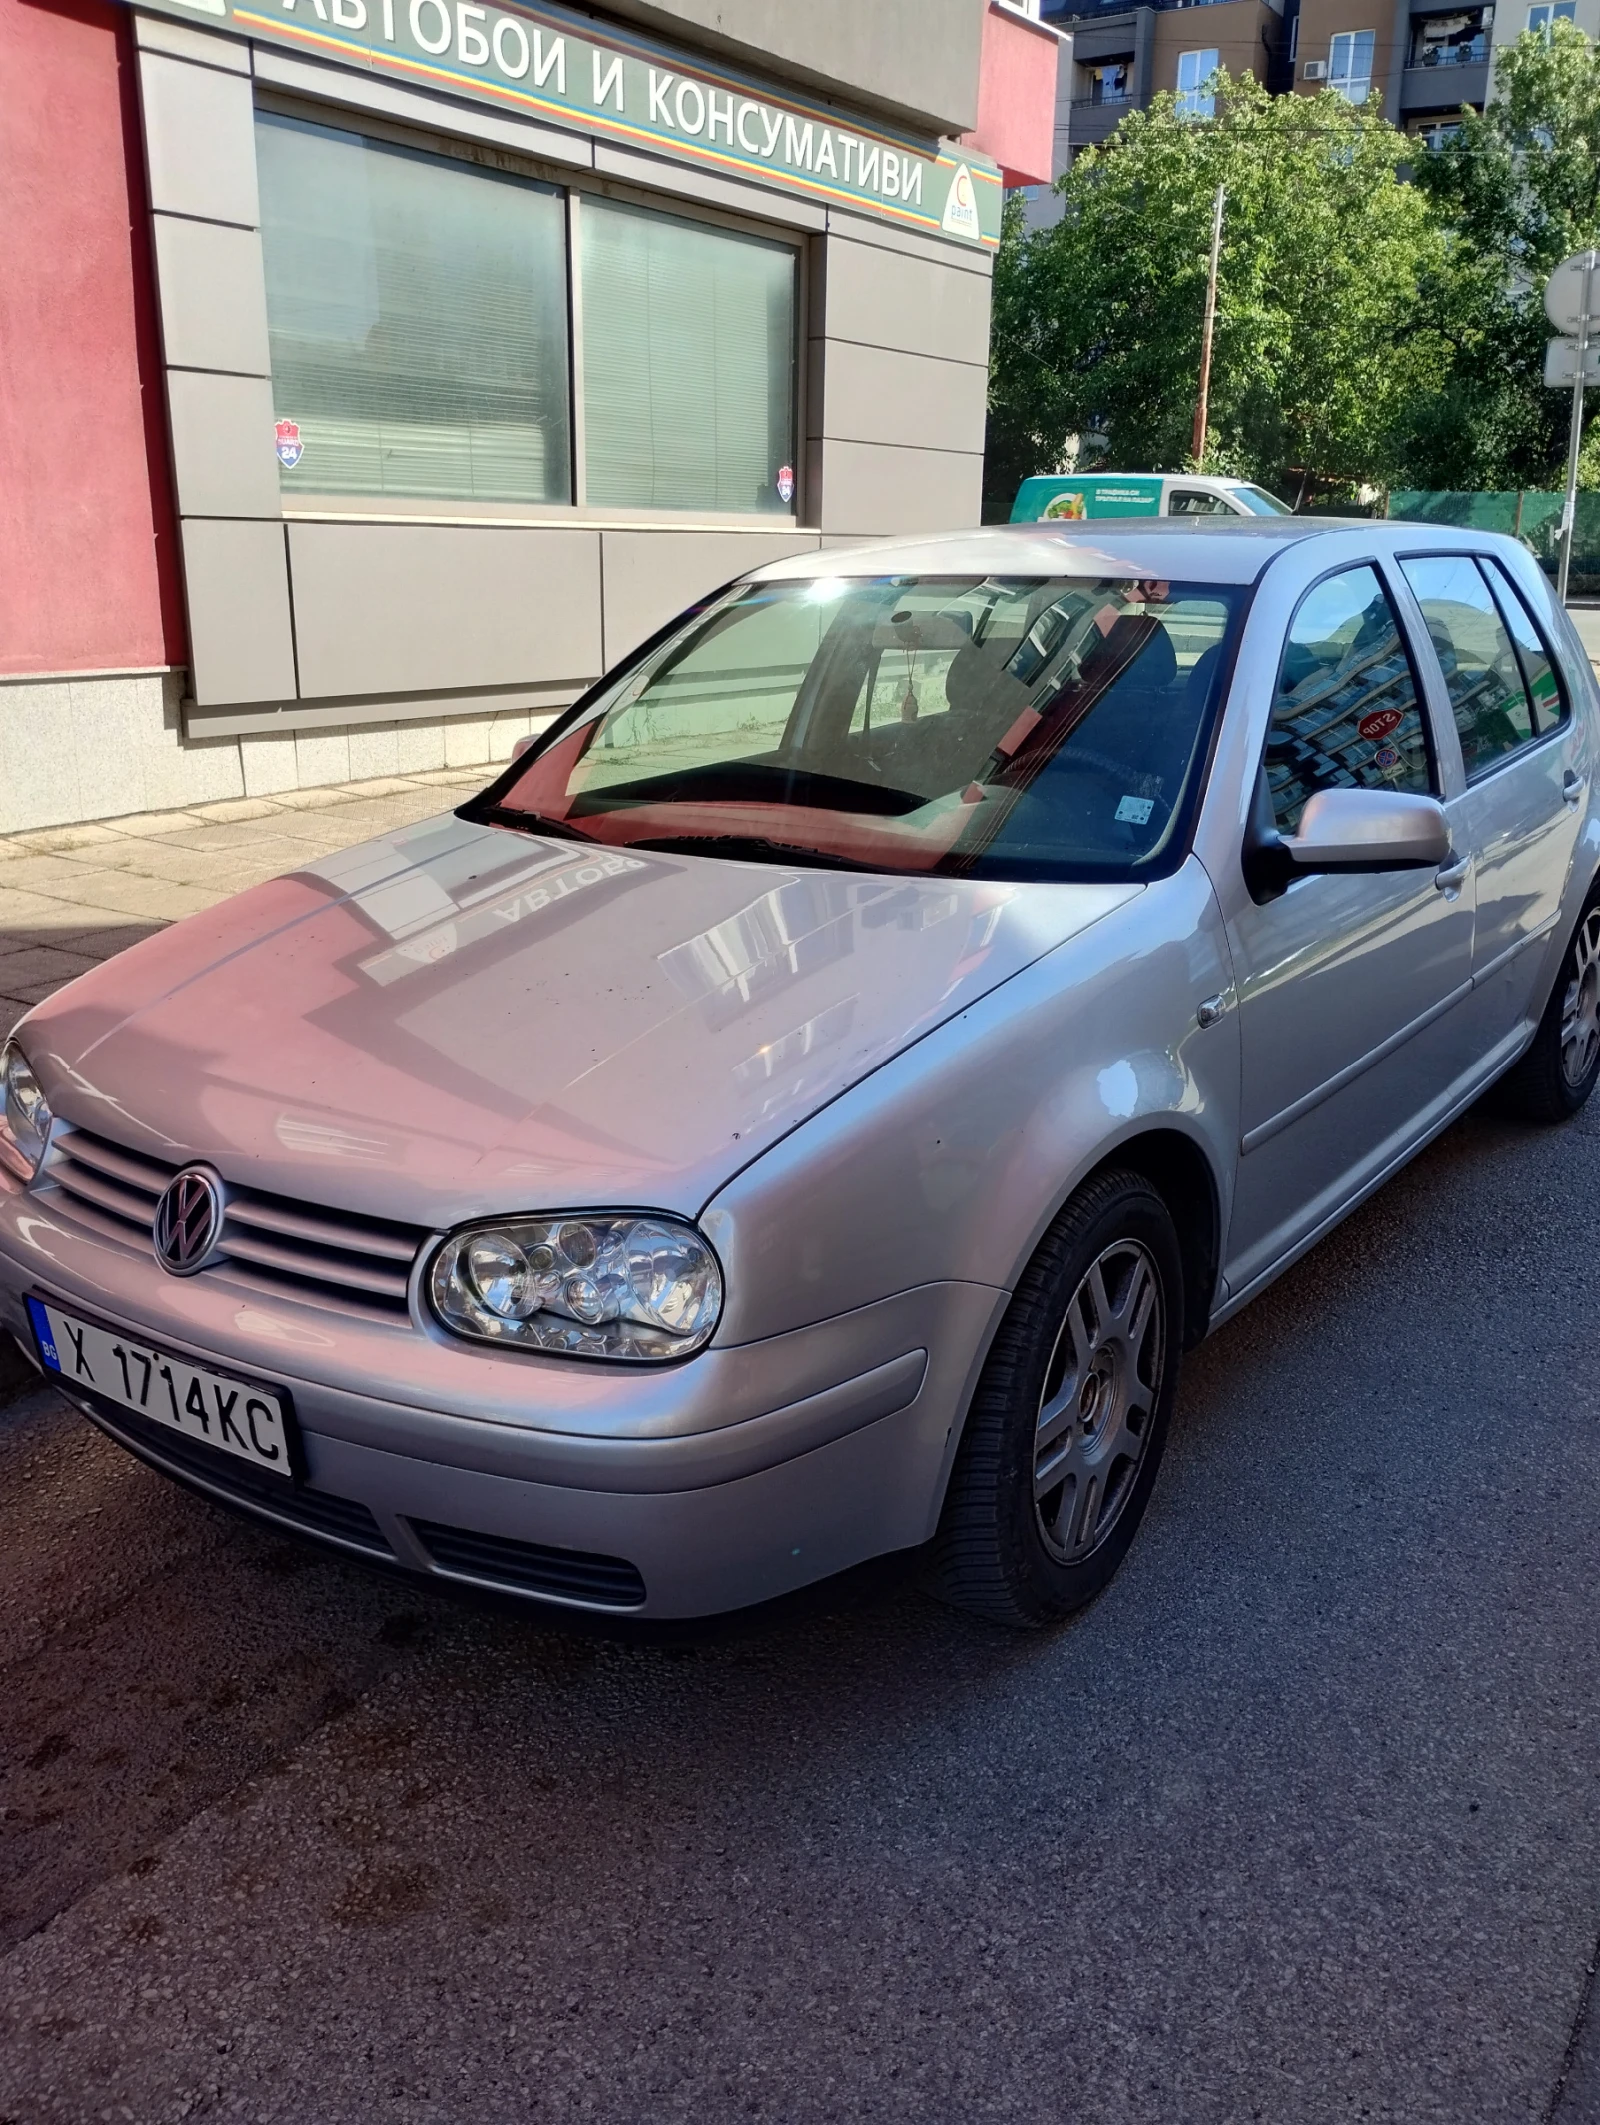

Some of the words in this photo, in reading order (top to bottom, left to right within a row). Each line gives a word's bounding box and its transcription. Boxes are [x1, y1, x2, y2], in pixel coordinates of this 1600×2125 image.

[282, 0, 566, 94] ТОБОИ
[593, 50, 624, 112] И
[648, 69, 923, 205] КОНСУМАТИВИ
[281, 446, 298, 460] 24
[41, 1339, 58, 1361] BG
